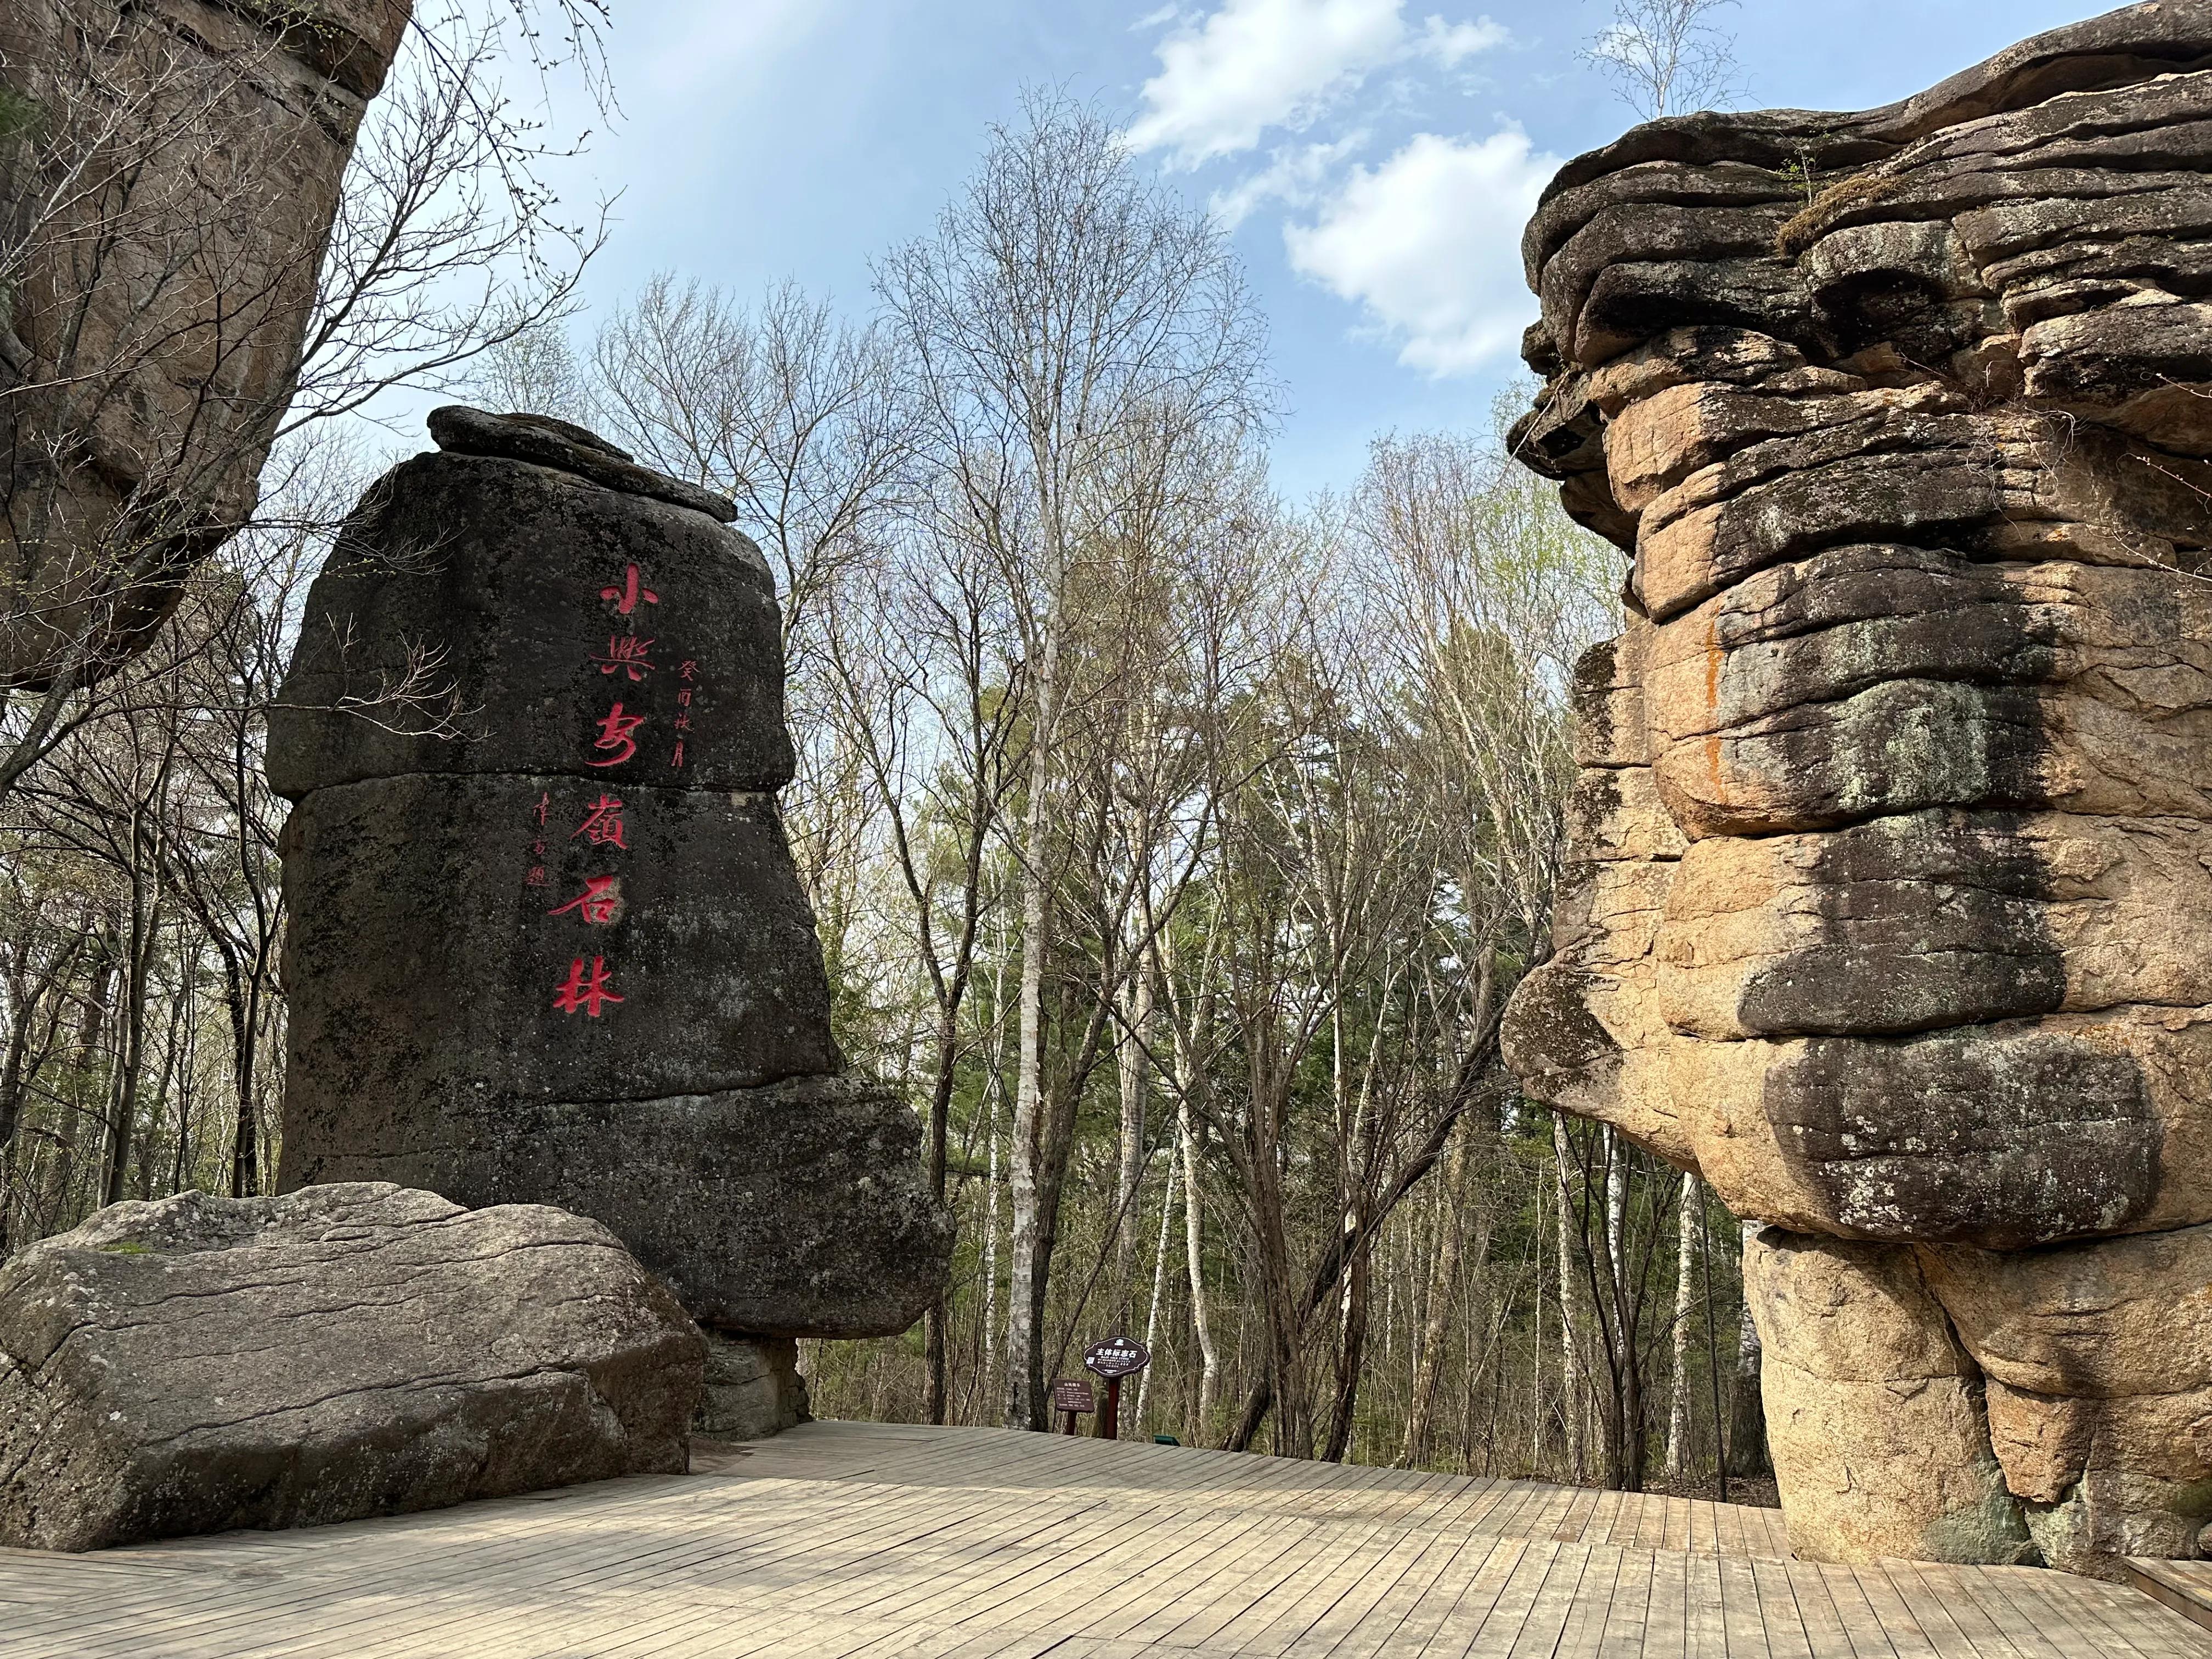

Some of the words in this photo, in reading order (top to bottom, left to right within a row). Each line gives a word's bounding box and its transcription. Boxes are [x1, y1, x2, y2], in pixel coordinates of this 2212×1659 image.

[1096, 1348, 1138, 1358] 主体标志石
